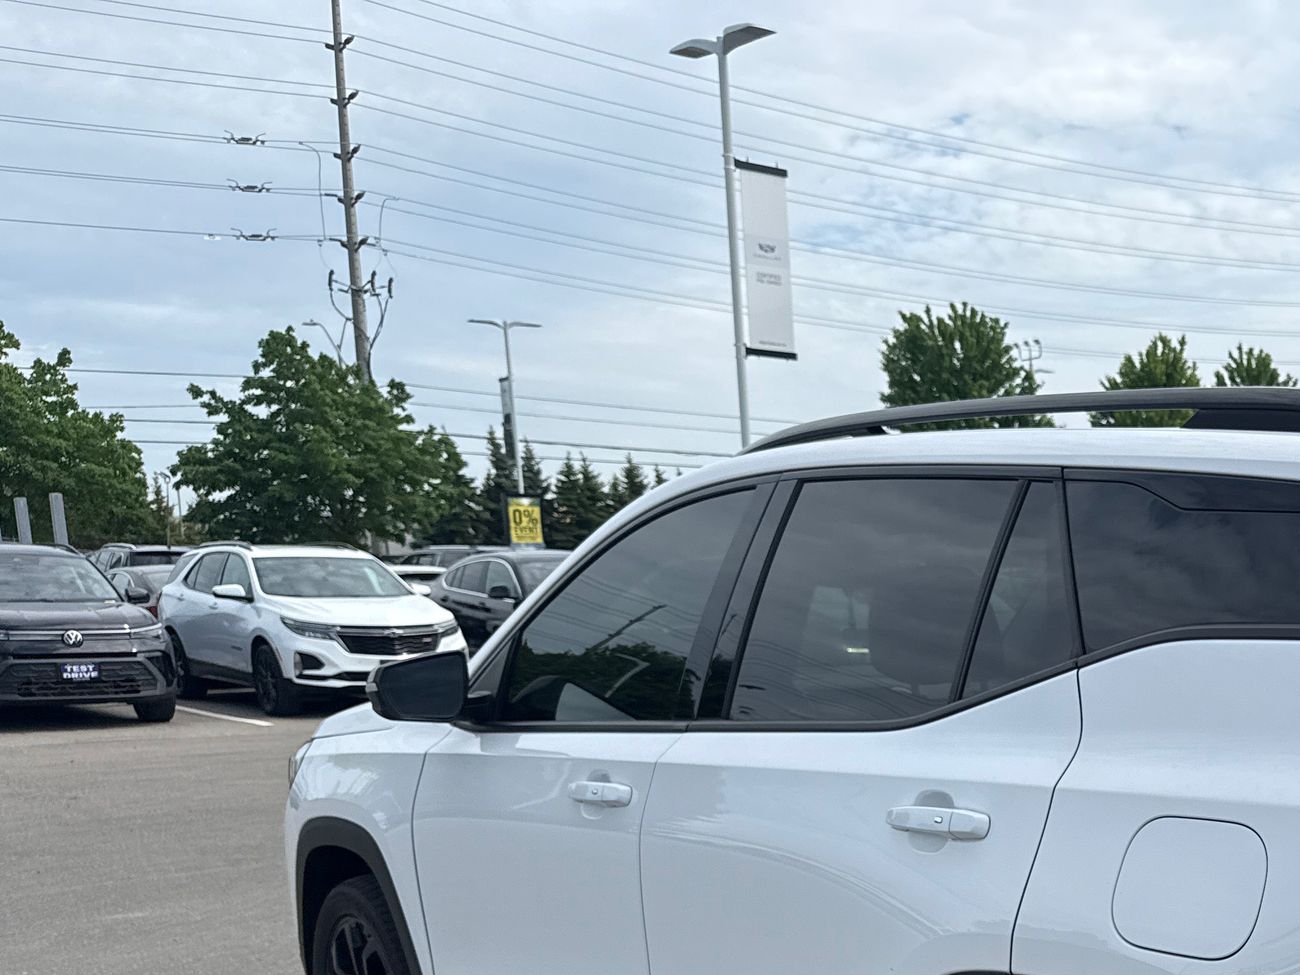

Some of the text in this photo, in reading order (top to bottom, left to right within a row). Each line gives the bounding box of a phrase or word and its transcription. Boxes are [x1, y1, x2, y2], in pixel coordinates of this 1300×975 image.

[513, 508, 538, 526] 0%
[514, 526, 538, 536] EVENT
[64, 664, 95, 672] TEST
[63, 671, 98, 679] DRIVE
